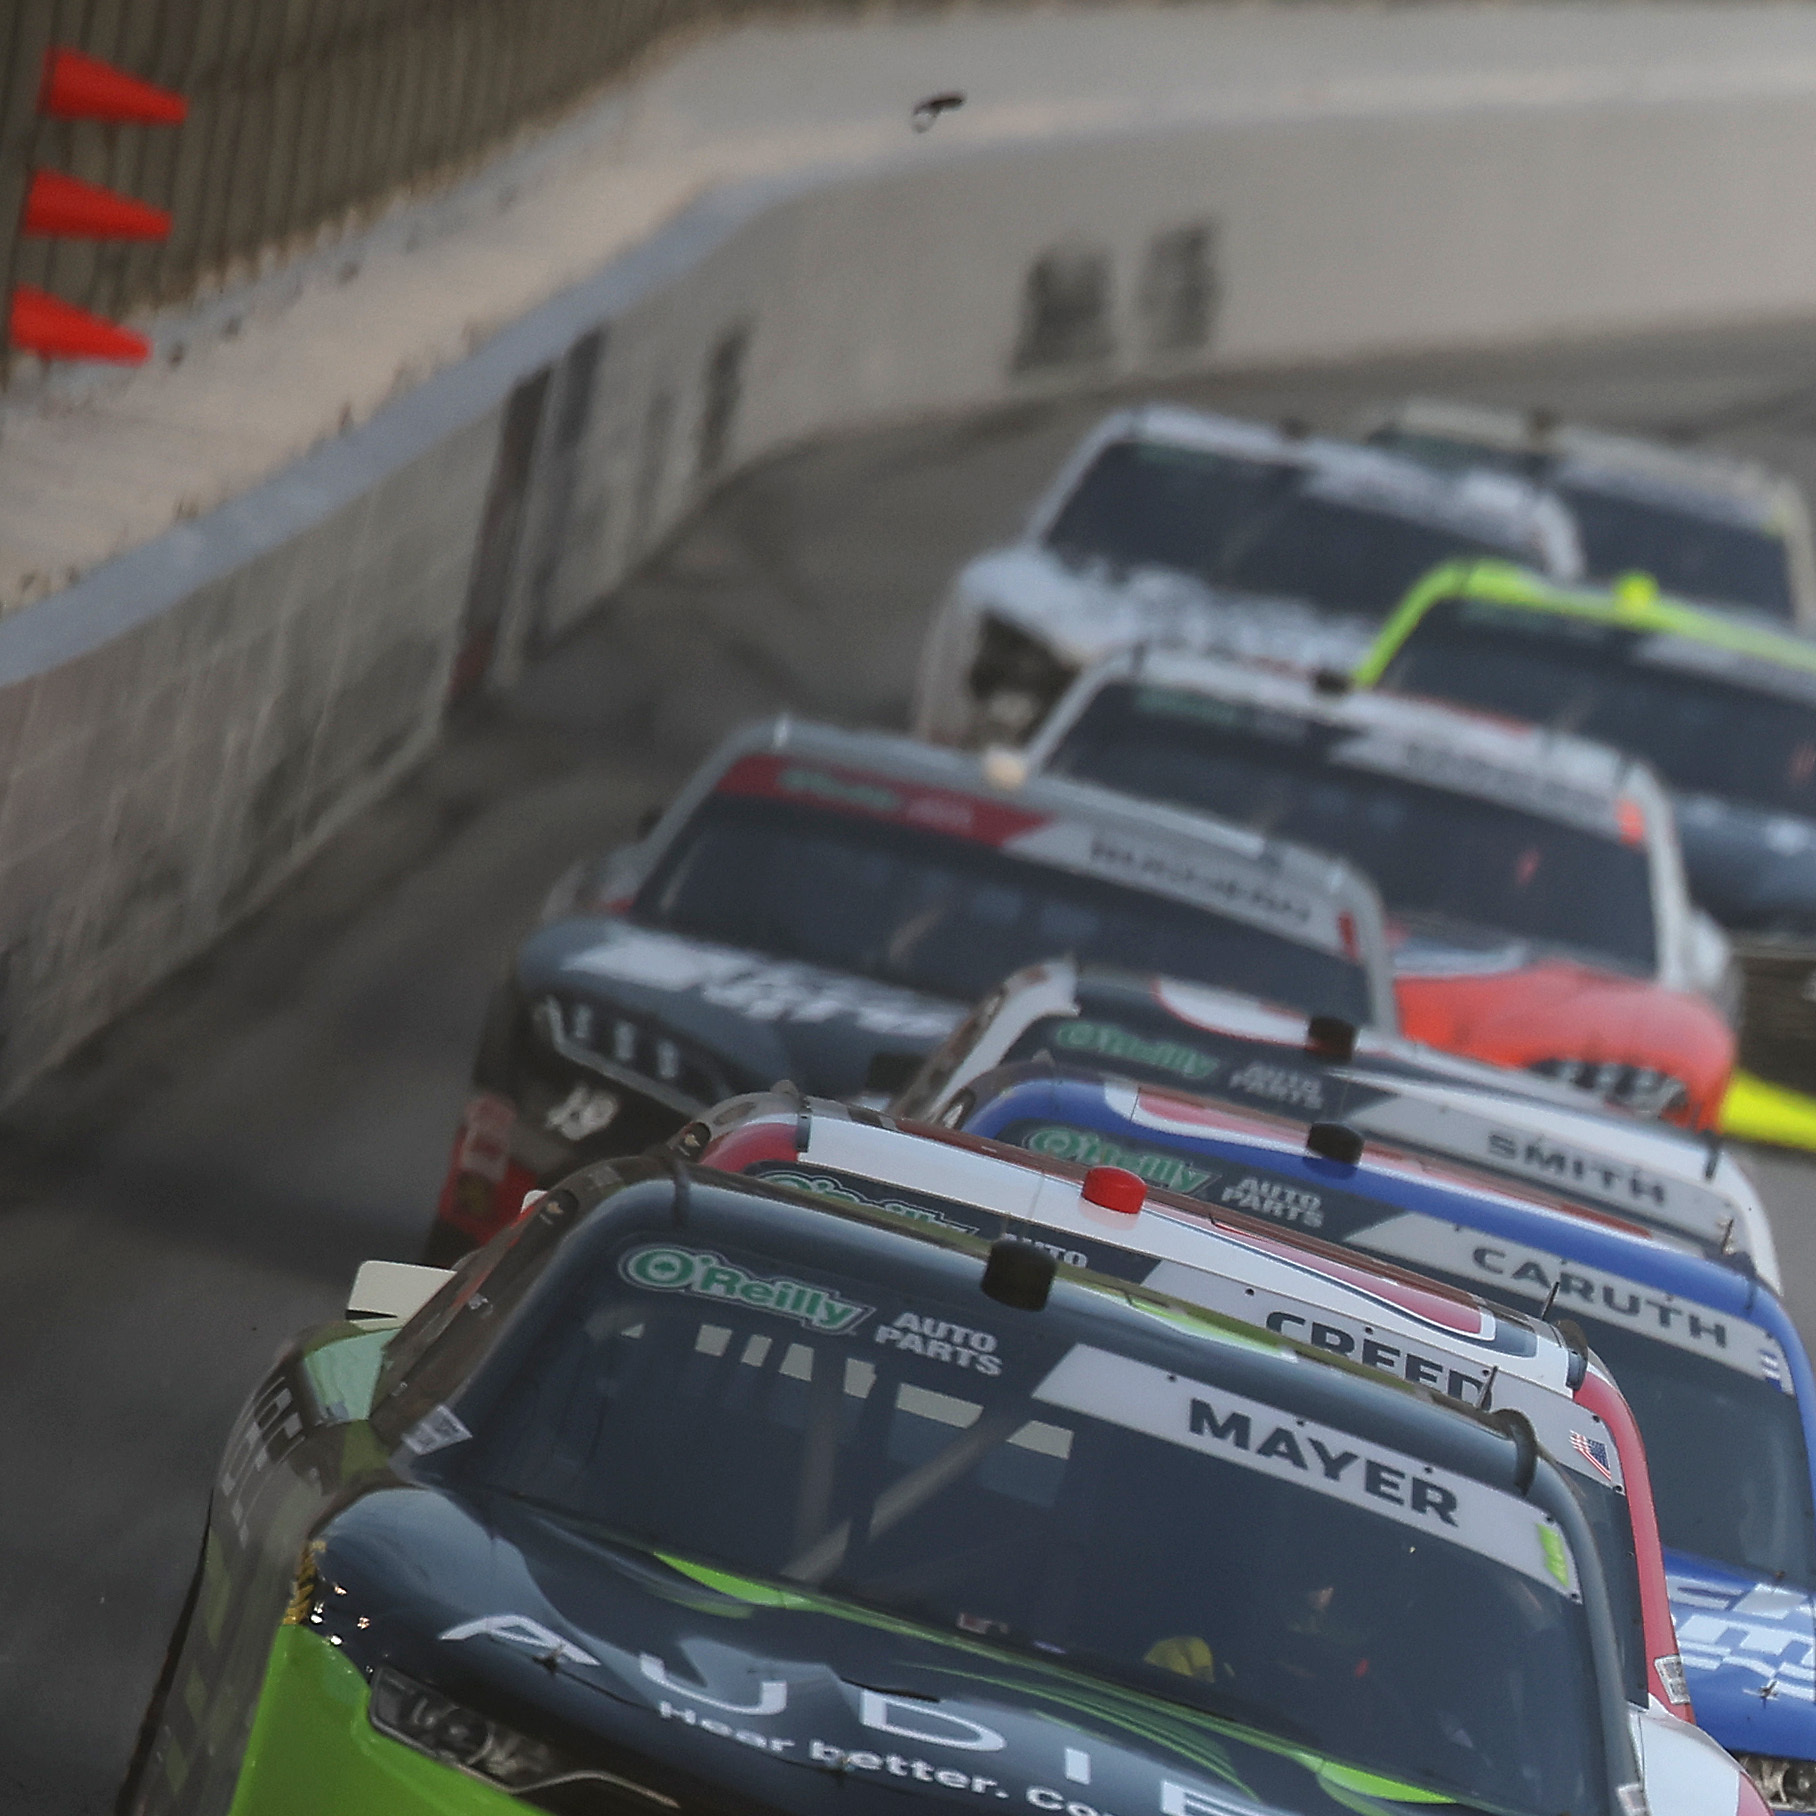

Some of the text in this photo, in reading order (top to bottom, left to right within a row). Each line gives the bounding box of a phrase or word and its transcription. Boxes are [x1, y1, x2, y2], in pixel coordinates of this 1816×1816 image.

[1239, 1178, 1321, 1211] AUTO
[1486, 1132, 1666, 1206] SMITH
[1222, 1188, 1323, 1228] PARTS
[1003, 1233, 1089, 1268] TO
[622, 1245, 874, 1333] O'Reilly
[1472, 1246, 1728, 1349] CARUTH
[875, 1325, 1003, 1377] PARTS
[900, 1312, 998, 1353] AUTO
[1266, 1311, 1492, 1405] CREED
[1188, 1397, 1459, 1528] MAYER
[658, 1700, 796, 1754] Hear
[808, 1738, 1010, 1800] better.
